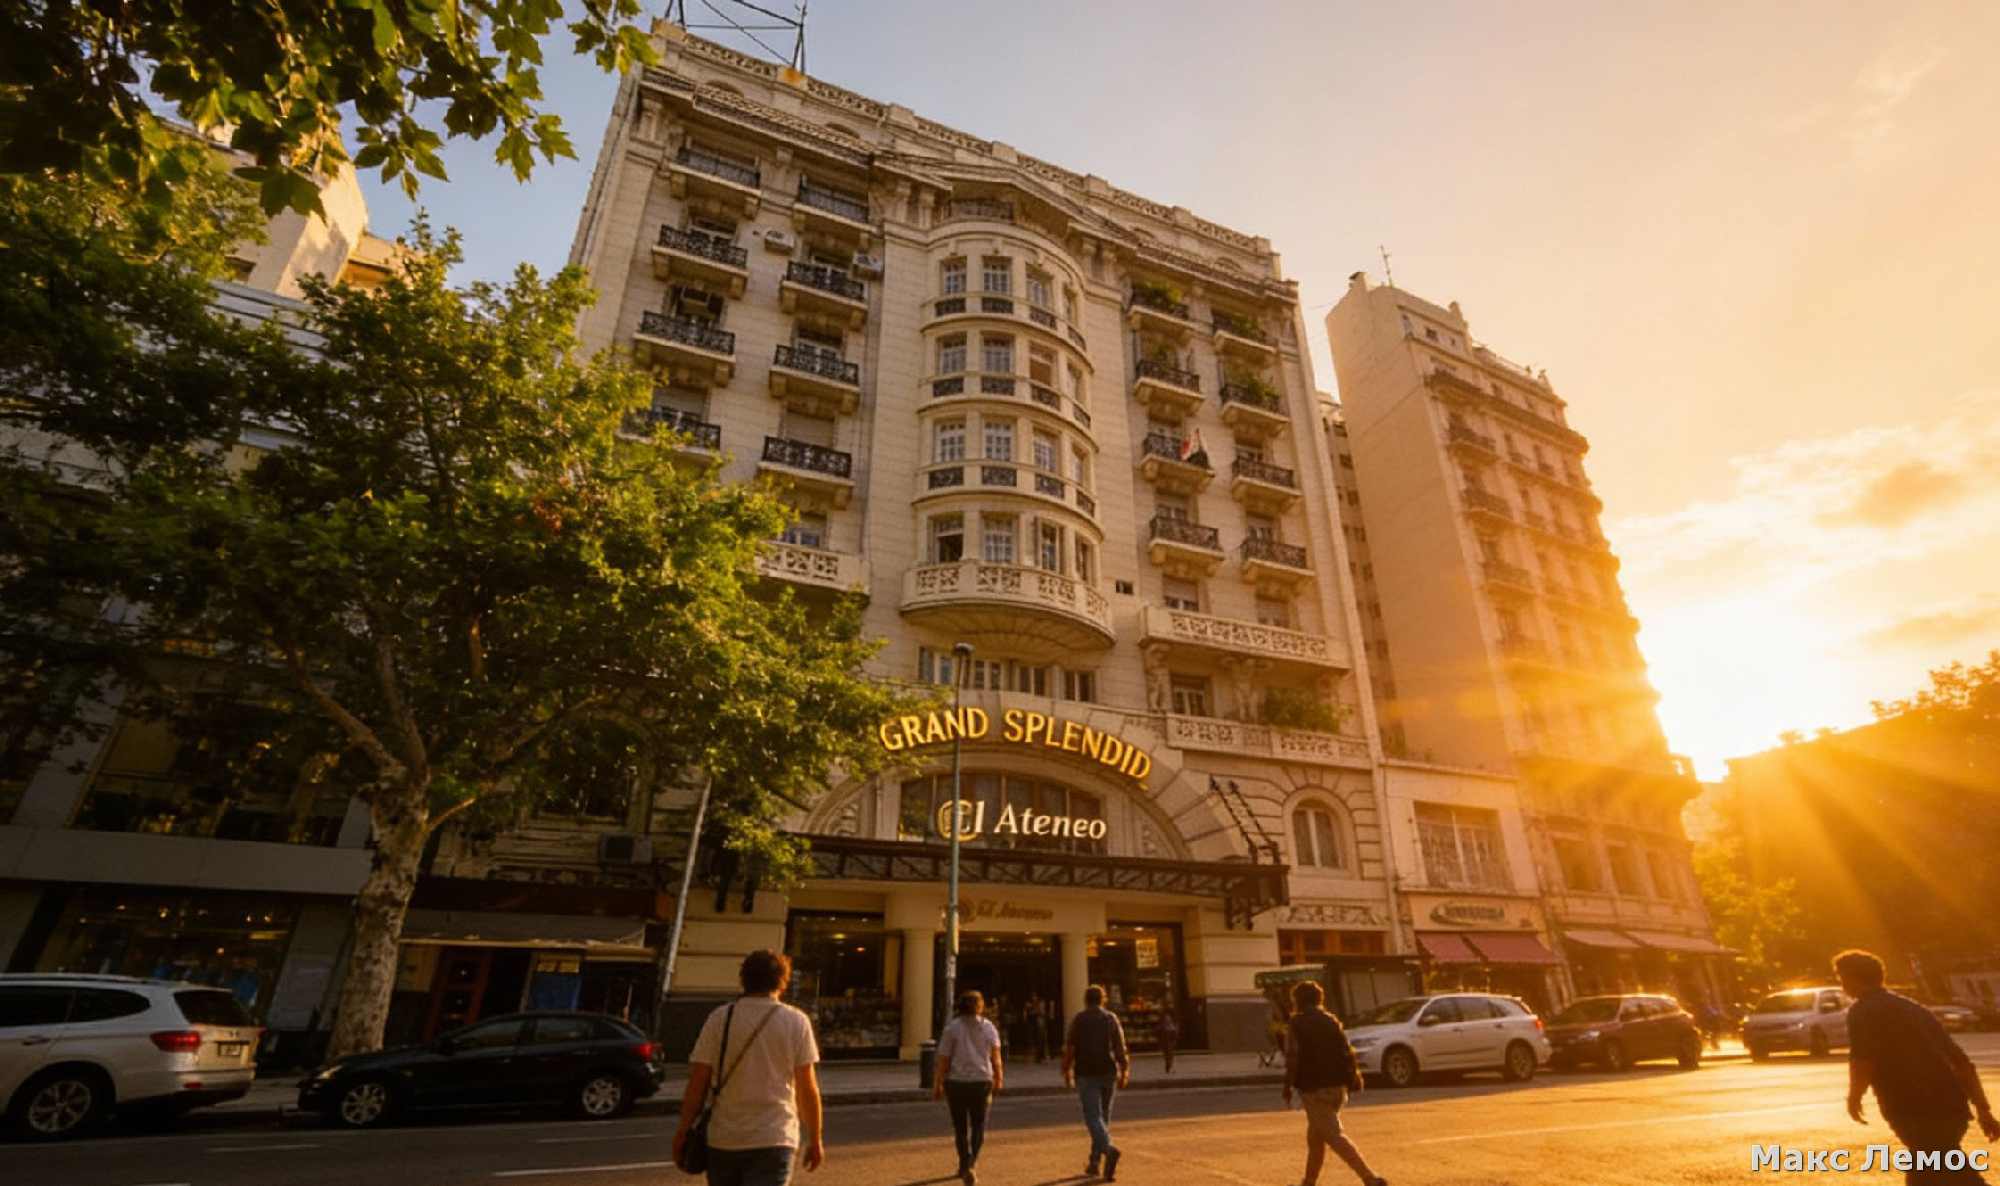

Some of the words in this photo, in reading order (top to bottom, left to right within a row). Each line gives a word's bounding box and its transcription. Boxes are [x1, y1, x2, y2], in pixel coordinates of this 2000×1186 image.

[880, 707, 989, 750] GRAND
[1003, 709, 1151, 779] SPLENDID
[994, 802, 1107, 840] Ateneo
